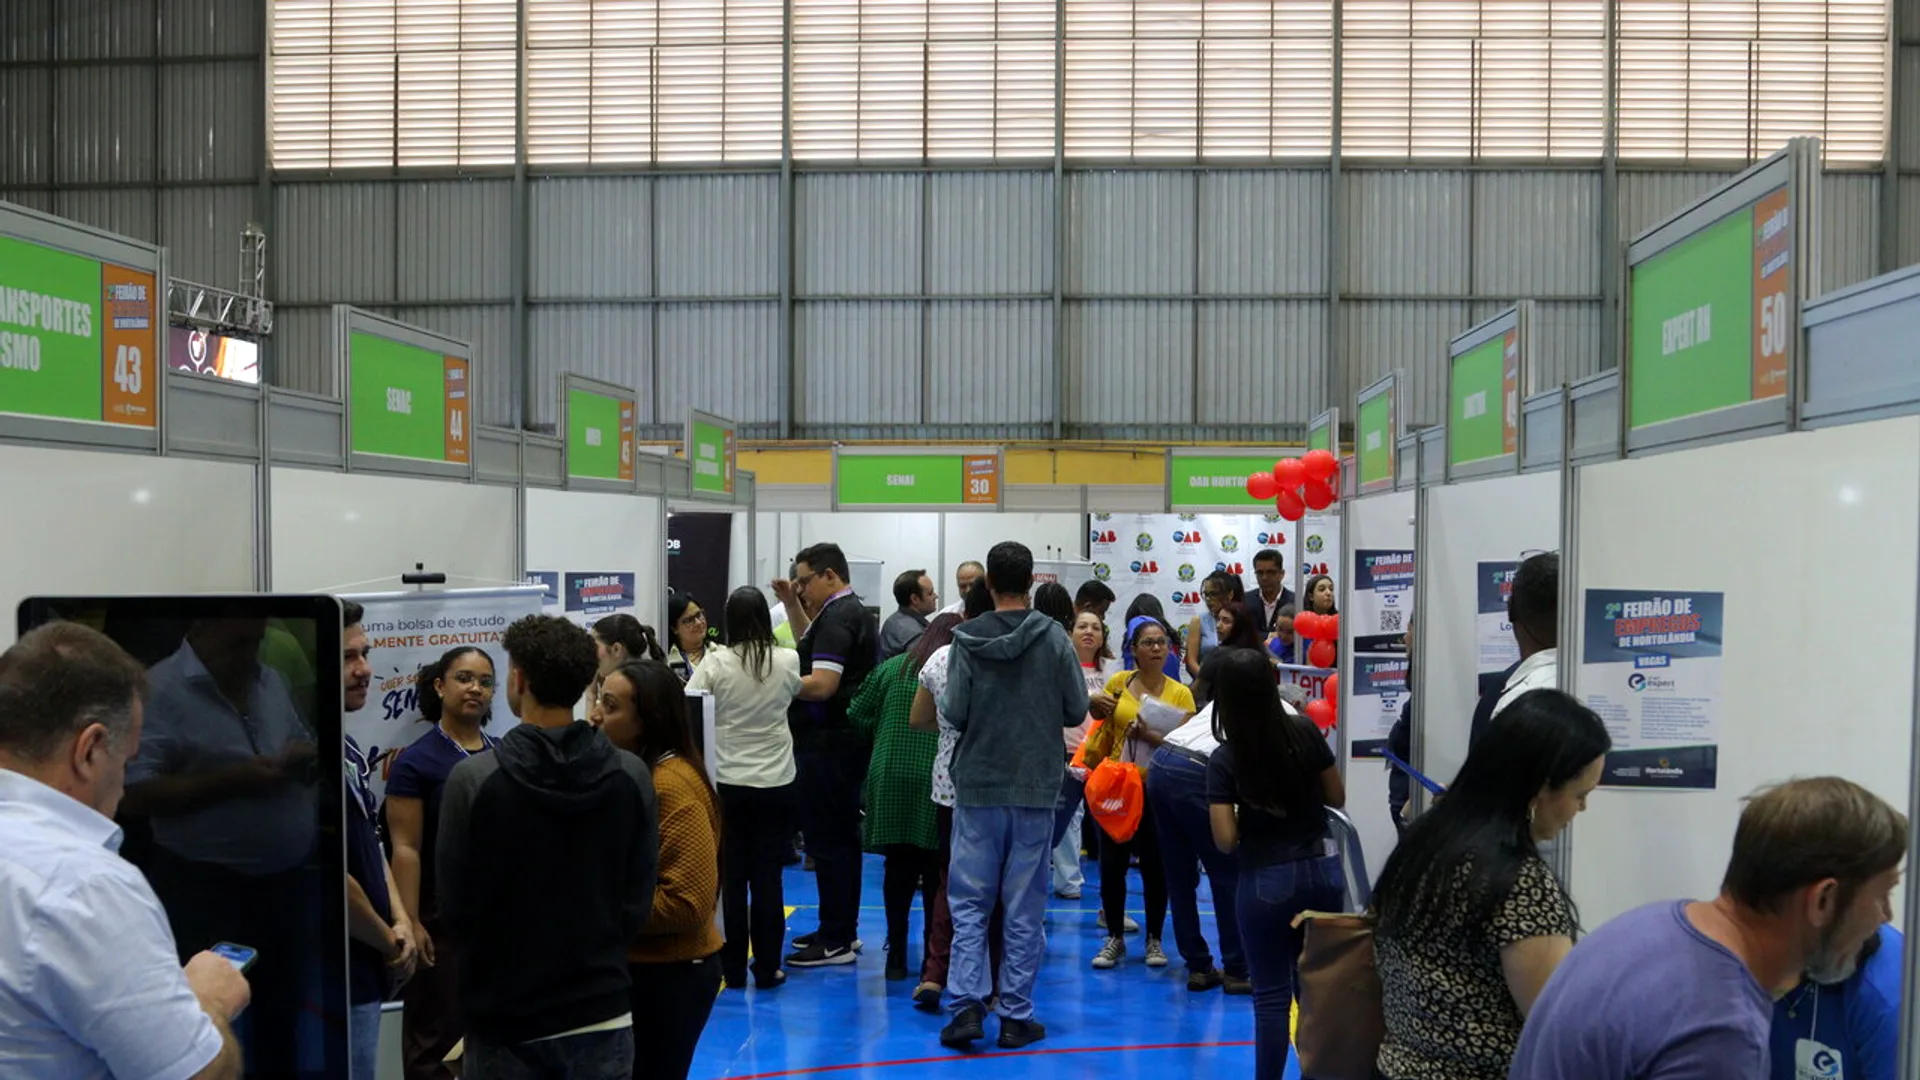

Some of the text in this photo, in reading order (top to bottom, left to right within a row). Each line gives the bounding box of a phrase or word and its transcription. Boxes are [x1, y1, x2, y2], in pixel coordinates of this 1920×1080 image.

[1662, 308, 1696, 356] EXPERT
[1761, 291, 1786, 357] 50
[114, 344, 142, 394] 43
[450, 408, 463, 442] 44
[970, 478, 989, 495] 30
[1172, 530, 1202, 543] OAB
[1257, 532, 1286, 545] OAB
[1130, 560, 1159, 573] OAB
[1171, 591, 1201, 604] OAB
[1623, 597, 1672, 619] FEIRÃO
[1674, 598, 1692, 615] DE
[397, 618, 434, 631] bolsa
[437, 616, 456, 629] de
[458, 614, 506, 628] estudo
[369, 635, 425, 649] MENTE
[382, 688, 421, 721] SEN
